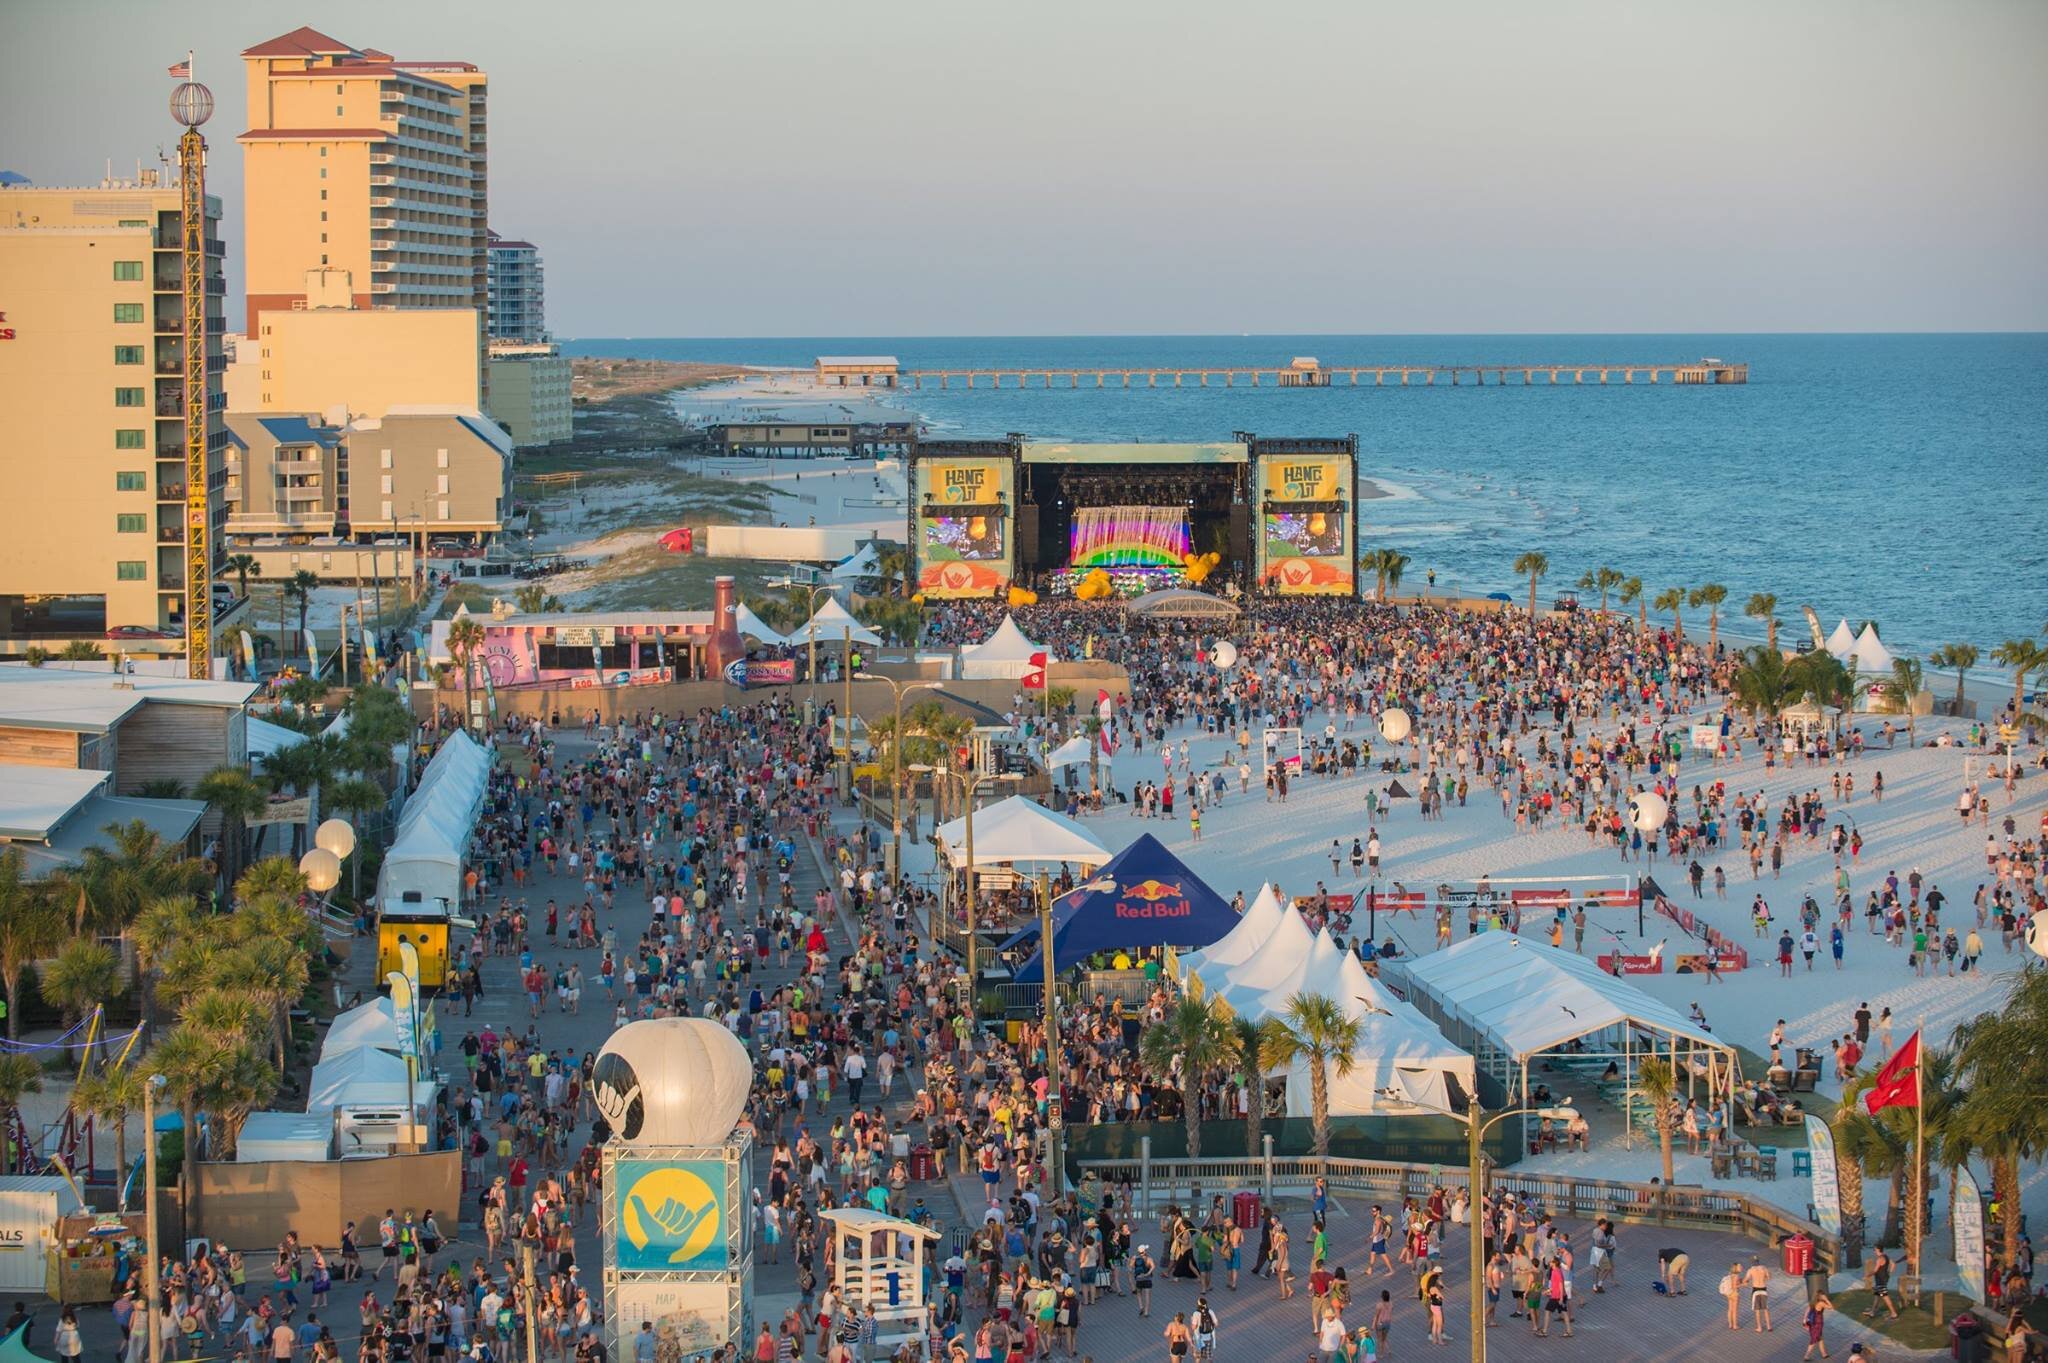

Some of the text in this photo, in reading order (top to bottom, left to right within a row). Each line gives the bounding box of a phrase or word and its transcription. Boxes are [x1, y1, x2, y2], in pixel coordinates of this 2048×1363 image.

[945, 468, 986, 486] HANG
[1284, 465, 1323, 483] HANG
[1116, 900, 1191, 918] Red Bull
[656, 1293, 676, 1305] MAP
